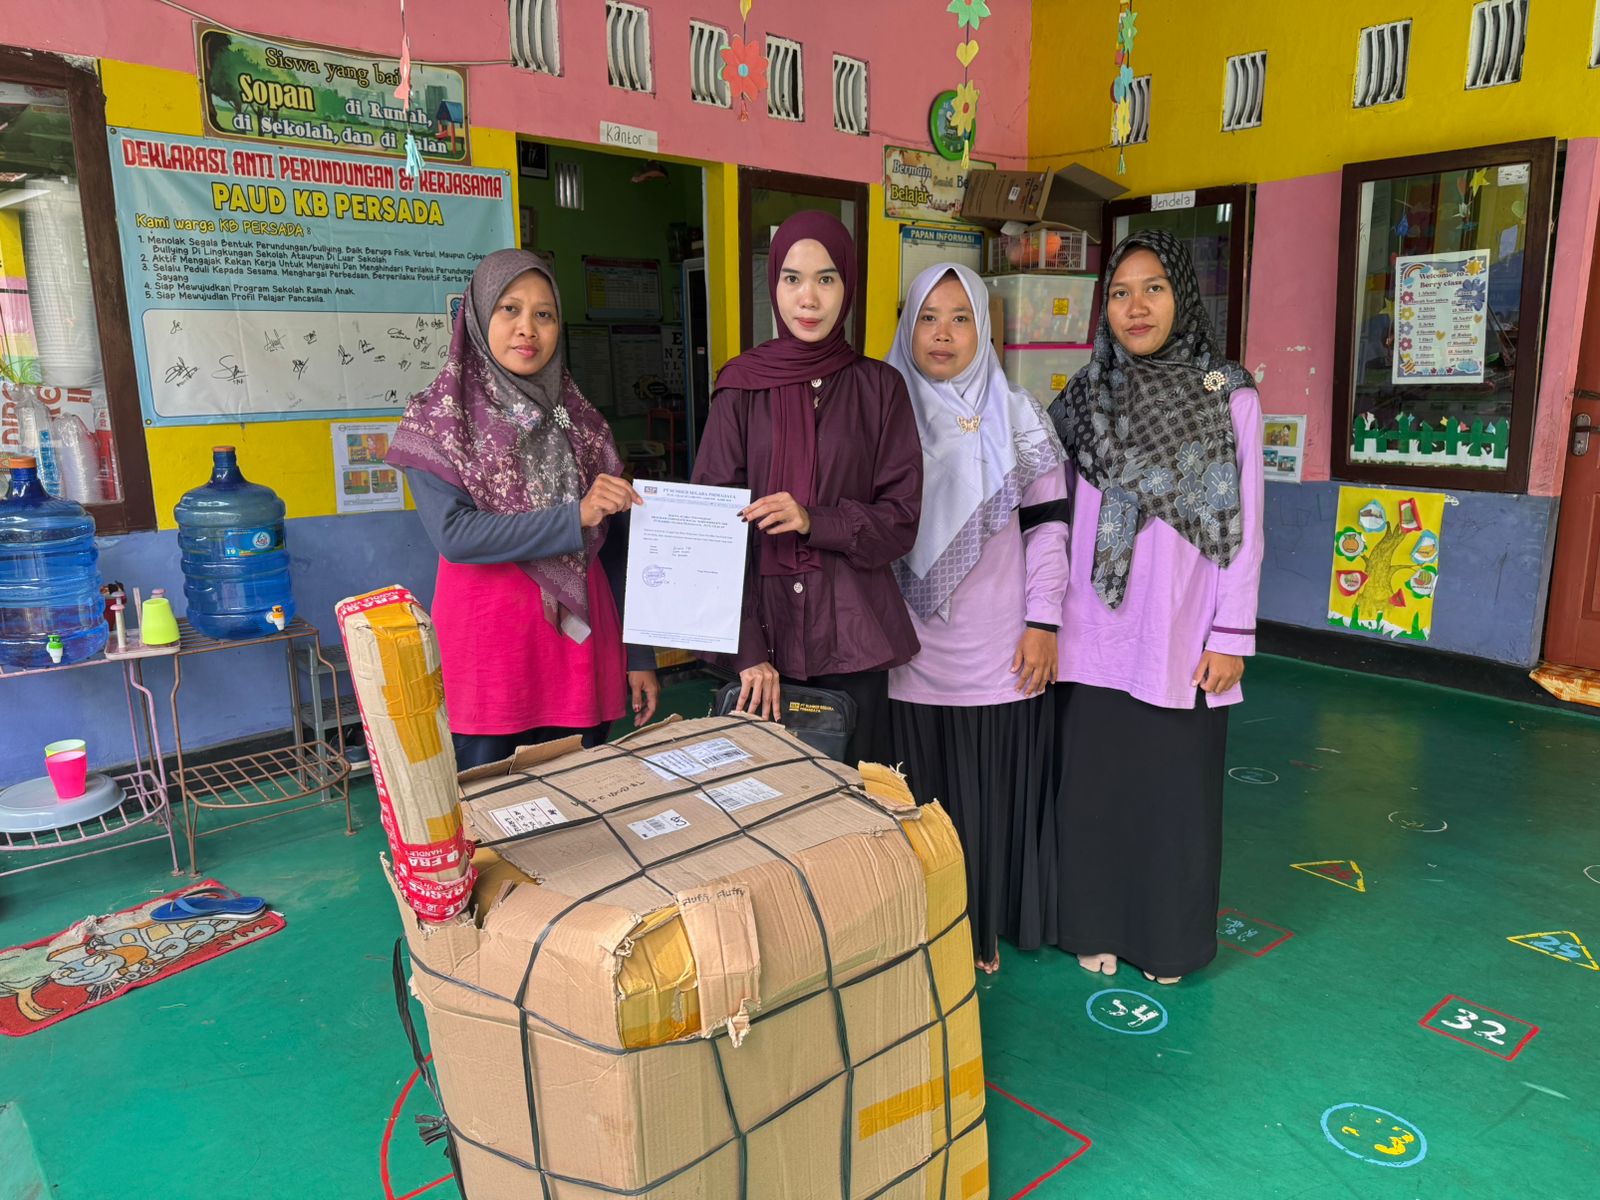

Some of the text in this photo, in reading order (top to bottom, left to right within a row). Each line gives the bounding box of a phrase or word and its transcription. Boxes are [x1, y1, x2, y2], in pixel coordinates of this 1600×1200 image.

[265, 47, 401, 88] Siswa yang bai
[238, 73, 432, 126] Sopan di Rumah,
[233, 113, 448, 153] di Sekolah, dan di alan
[606, 123, 643, 145] Kantor
[121, 138, 229, 175] DEKLARASI
[232, 150, 276, 179] ANTI
[279, 156, 394, 190] PERUNDUNGAN
[419, 171, 502, 198] KERJASAMA
[892, 158, 932, 181] Bermain
[211, 181, 444, 226] PAUD KB PERSADA
[890, 184, 930, 207] Belajar
[1151, 191, 1191, 210] Jendela
[135, 213, 170, 229] Kami
[174, 218, 216, 233] warga
[219, 217, 239, 233] KB
[242, 219, 305, 238] PERSADA
[148, 235, 185, 246] Menolak
[188, 238, 218, 248] Segala
[221, 239, 254, 249] Bentuk
[345, 246, 363, 254] Baik
[910, 229, 975, 244] PAPAN INFORMASI
[152, 254, 177, 263] Aktif
[180, 256, 221, 267] Mengajak
[224, 257, 252, 266] Rekan
[254, 258, 277, 268] Kerja
[279, 260, 304, 268] Untuk
[306, 261, 340, 271] Menjauhi
[343, 263, 357, 271] Dan
[360, 263, 403, 273] Menghindari
[405, 265, 434, 274] Perilaku
[153, 245, 189, 256] Bullying
[192, 246, 201, 255] Di
[203, 247, 253, 258] Lingkungan
[256, 249, 288, 259] Sekolah
[291, 252, 325, 262] Ataupun
[337, 254, 355, 263] Luar
[153, 263, 181, 272] Selalu
[184, 264, 209, 274] Peduli
[212, 266, 244, 276] Kepada
[282, 267, 328, 278] Menghargai
[372, 272, 415, 282] Berperilaku
[417, 273, 440, 282] Positif
[442, 274, 462, 283] Serta
[156, 273, 189, 283] Sayang
[1419, 271, 1453, 280] Welcome
[154, 282, 175, 291] Siap
[178, 282, 231, 293] Mewujudkan
[233, 284, 270, 294] Program
[272, 285, 304, 294] Sekolah
[307, 286, 332, 295] Ramah
[1420, 281, 1442, 290] Berry
[156, 291, 176, 300] Siap
[231, 292, 256, 301] Profil
[258, 293, 286, 303] Pelajar
[1529, 935, 1582, 959] 25
[1441, 1008, 1507, 1045] 32
